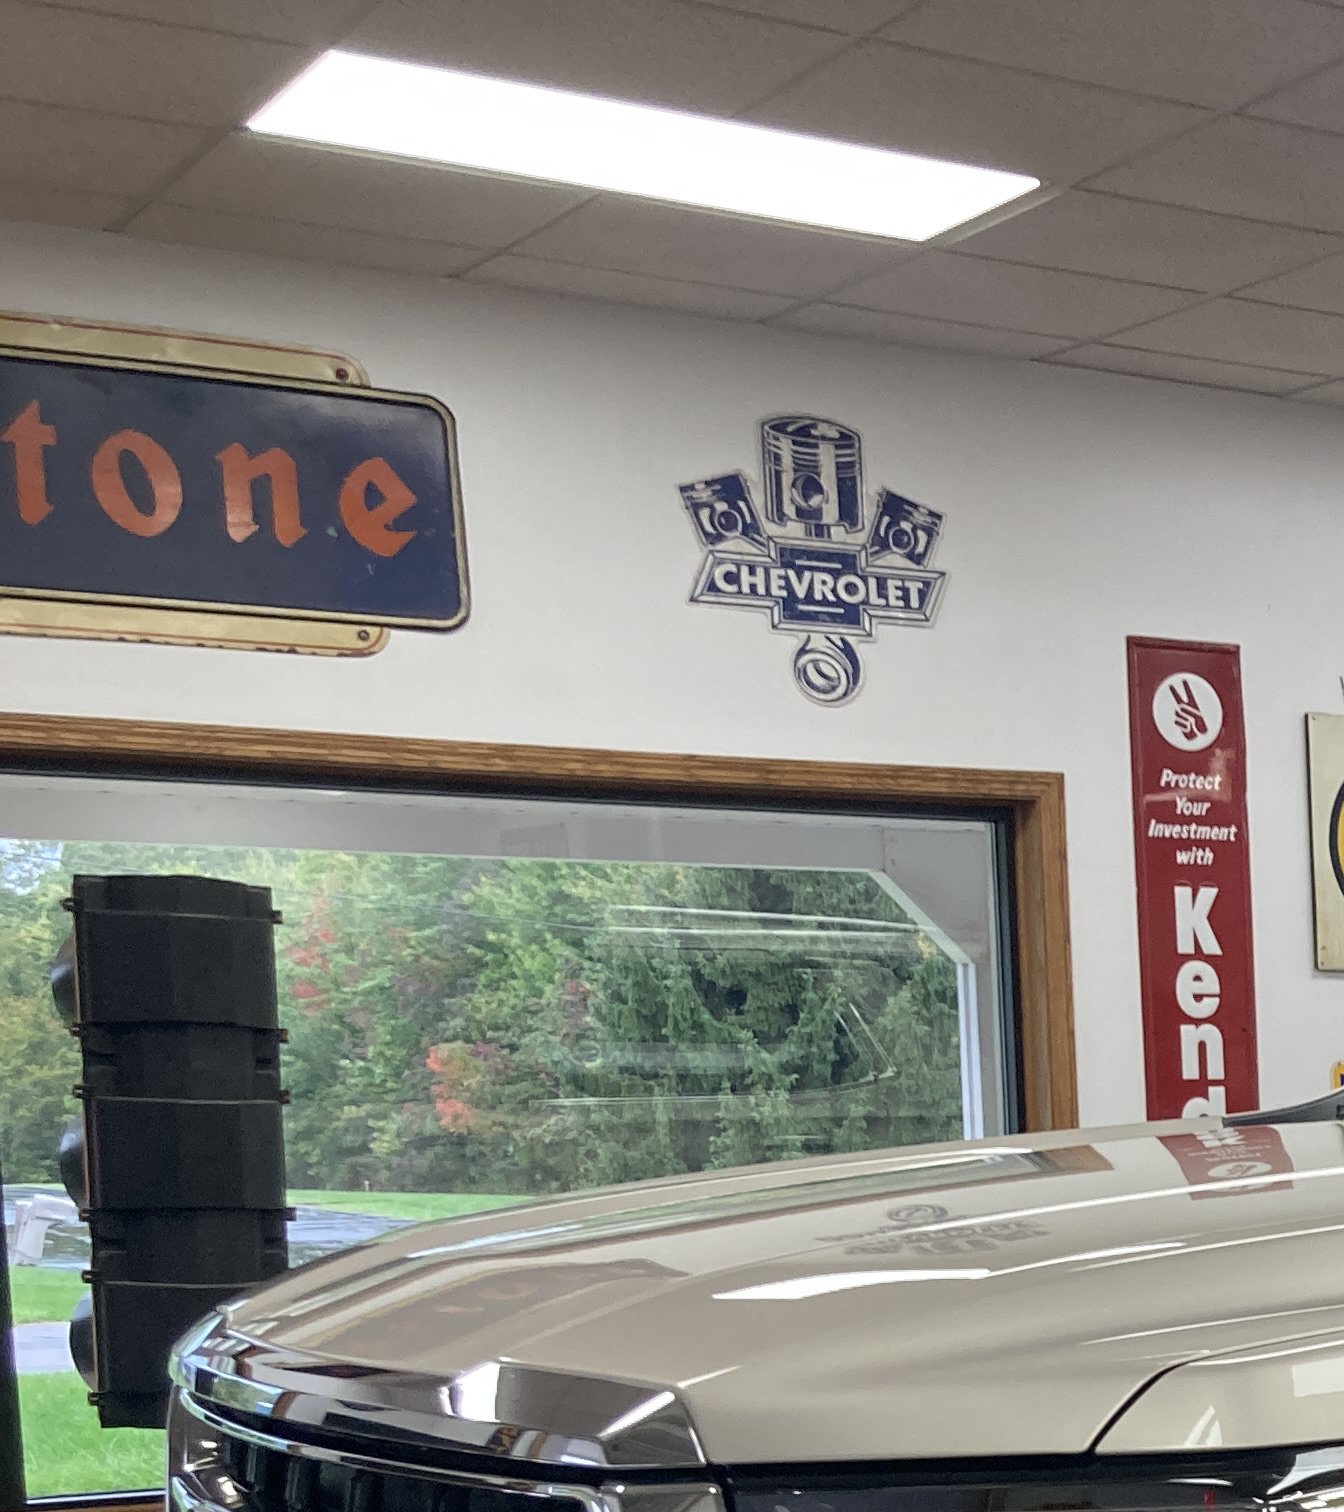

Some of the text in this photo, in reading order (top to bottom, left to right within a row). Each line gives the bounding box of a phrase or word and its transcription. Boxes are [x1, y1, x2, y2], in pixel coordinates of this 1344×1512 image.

[2, 399, 418, 558] tone
[713, 563, 925, 609] CHEVROLET
[1160, 768, 1222, 790] Protect
[1175, 796, 1211, 816] Your
[1148, 819, 1238, 841] Investment
[1175, 847, 1214, 866] with
